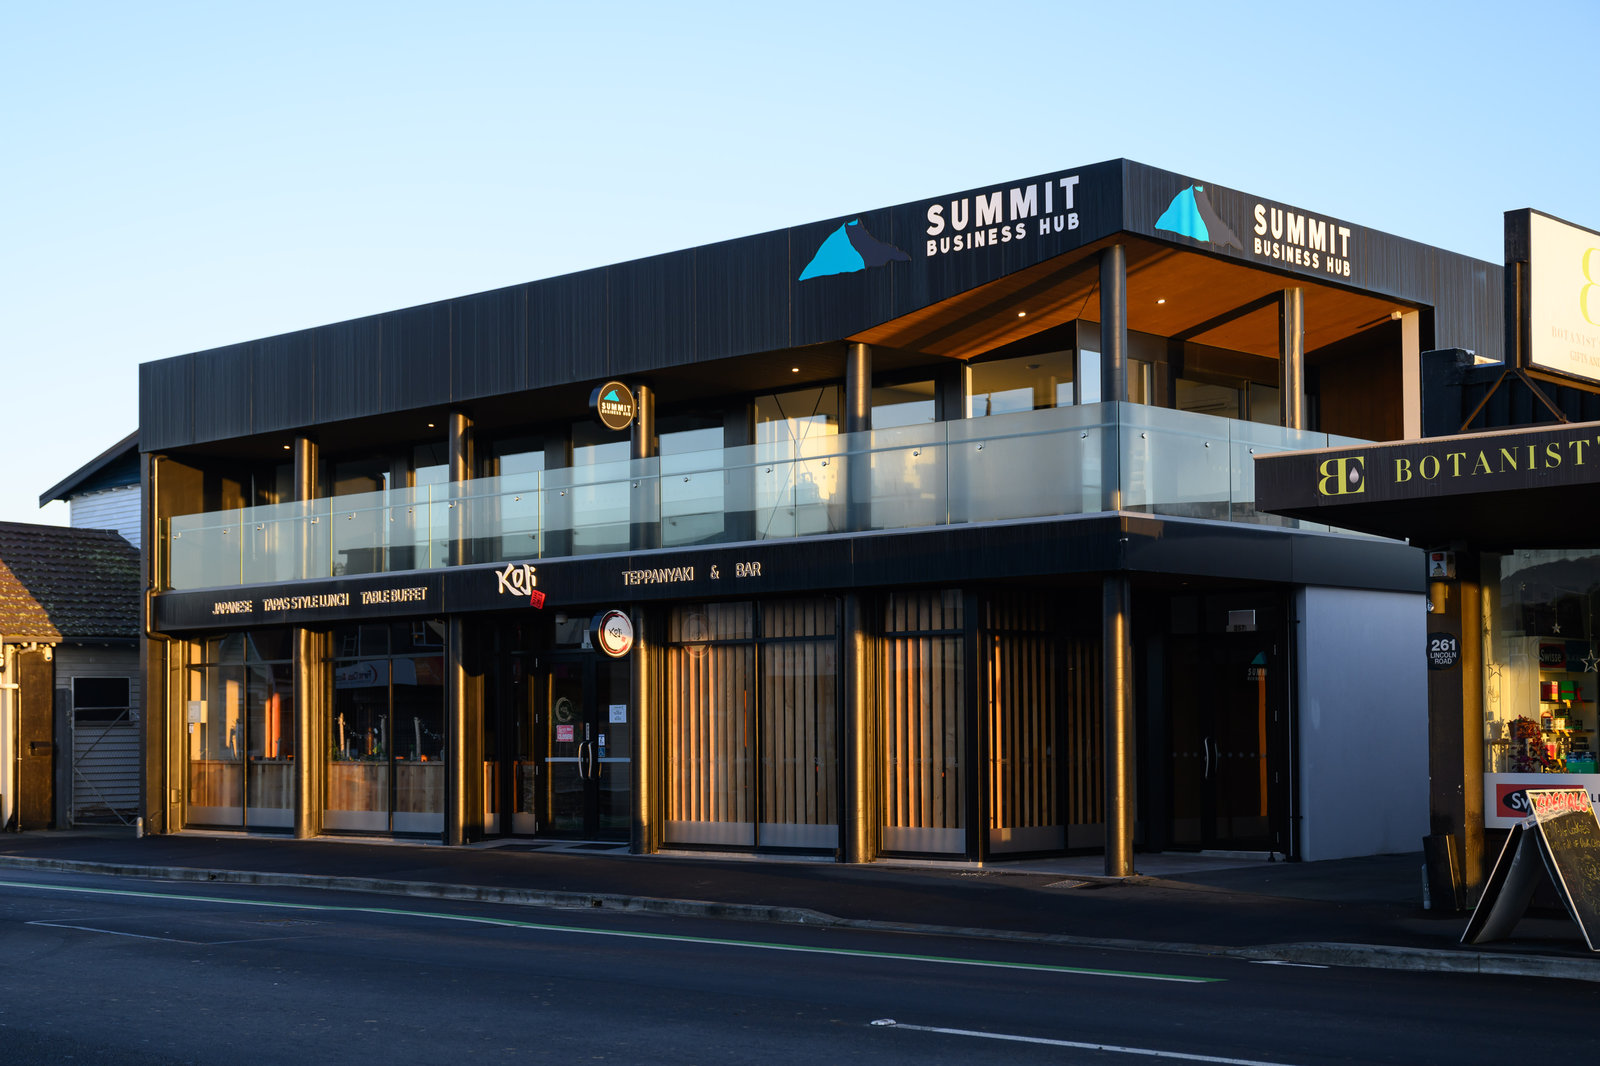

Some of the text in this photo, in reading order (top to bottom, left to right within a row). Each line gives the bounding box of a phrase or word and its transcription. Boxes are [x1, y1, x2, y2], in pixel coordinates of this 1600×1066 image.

[926, 175, 1079, 236] SUMMIT
[926, 212, 1079, 256] BUSINESS HUB
[1254, 204, 1350, 258] SUMMIT
[1254, 238, 1350, 277] BUSINESS HUB
[602, 402, 631, 412] SUMMIT
[621, 562, 761, 586] TEPPANYAKI & BAR
[212, 587, 428, 615] JAPANESE TAPAS STYLE LUNCH TABLE BUFFET
[1430, 651, 1456, 659] LINCOLN
[1431, 639, 1456, 652] 261
[1536, 792, 1588, 814] SPECIALS
